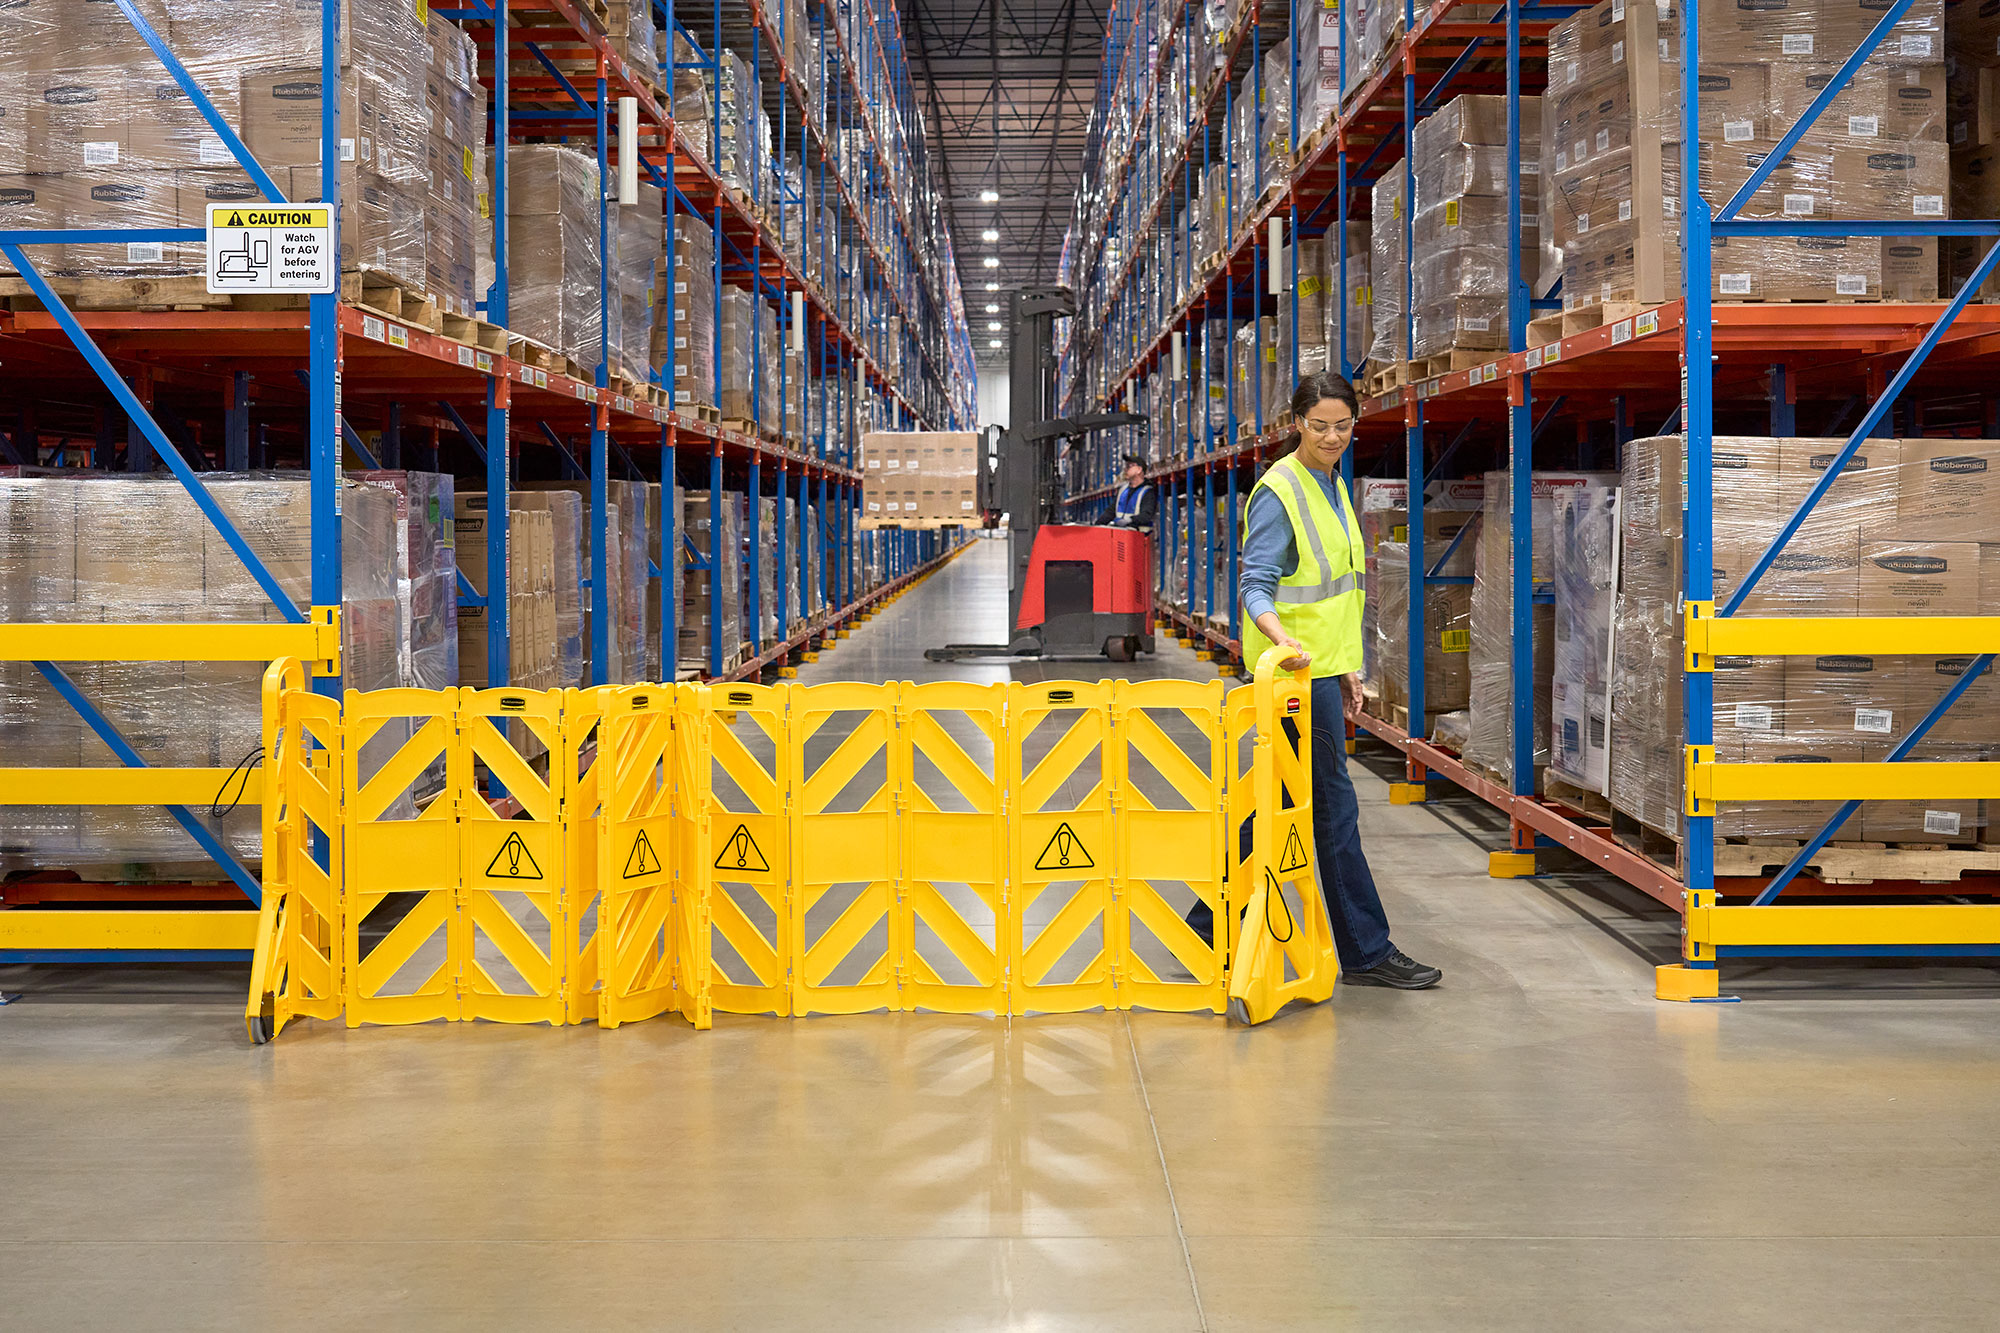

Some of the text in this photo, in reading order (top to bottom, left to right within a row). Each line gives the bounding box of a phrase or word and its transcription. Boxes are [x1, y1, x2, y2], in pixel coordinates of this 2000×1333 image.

[0, 193, 32, 201] bermaid
[248, 213, 311, 225] CAUTION
[285, 233, 315, 242] Watch
[281, 245, 319, 254] for AGV
[284, 257, 316, 266] before
[280, 270, 320, 280] entering
[1933, 461, 1985, 469] Rubbermaid
[1818, 661, 1871, 669] Rubbermaid
[1938, 663, 1990, 671] Rubbed
